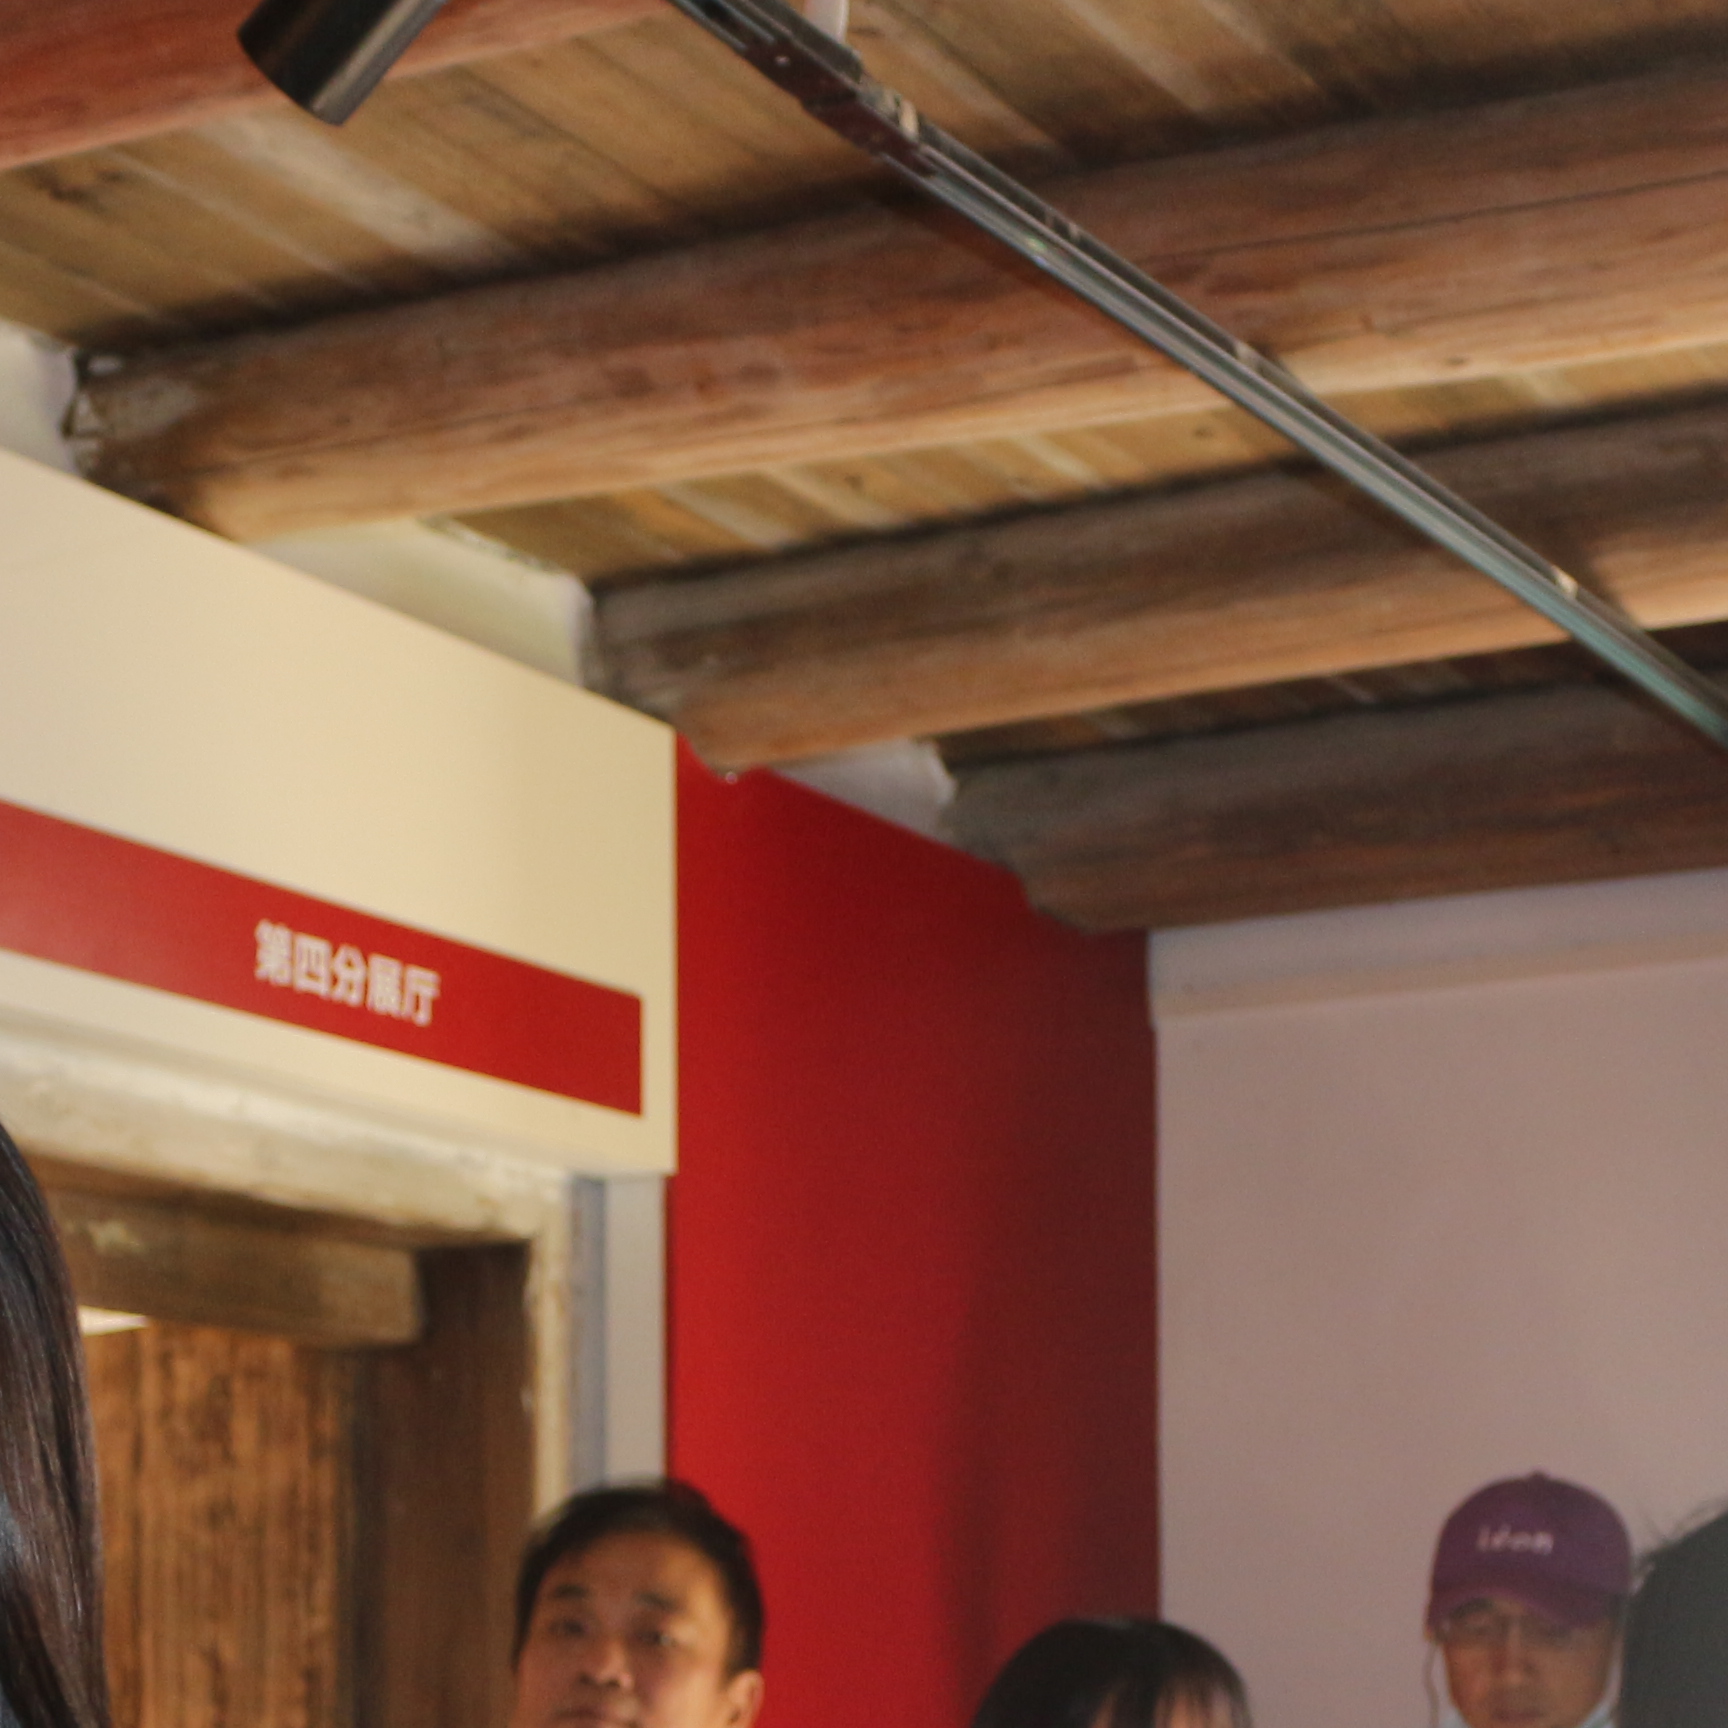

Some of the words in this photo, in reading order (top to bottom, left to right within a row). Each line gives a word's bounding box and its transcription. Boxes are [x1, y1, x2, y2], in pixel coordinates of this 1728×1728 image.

[253, 918, 442, 1027] 第四分展厅
